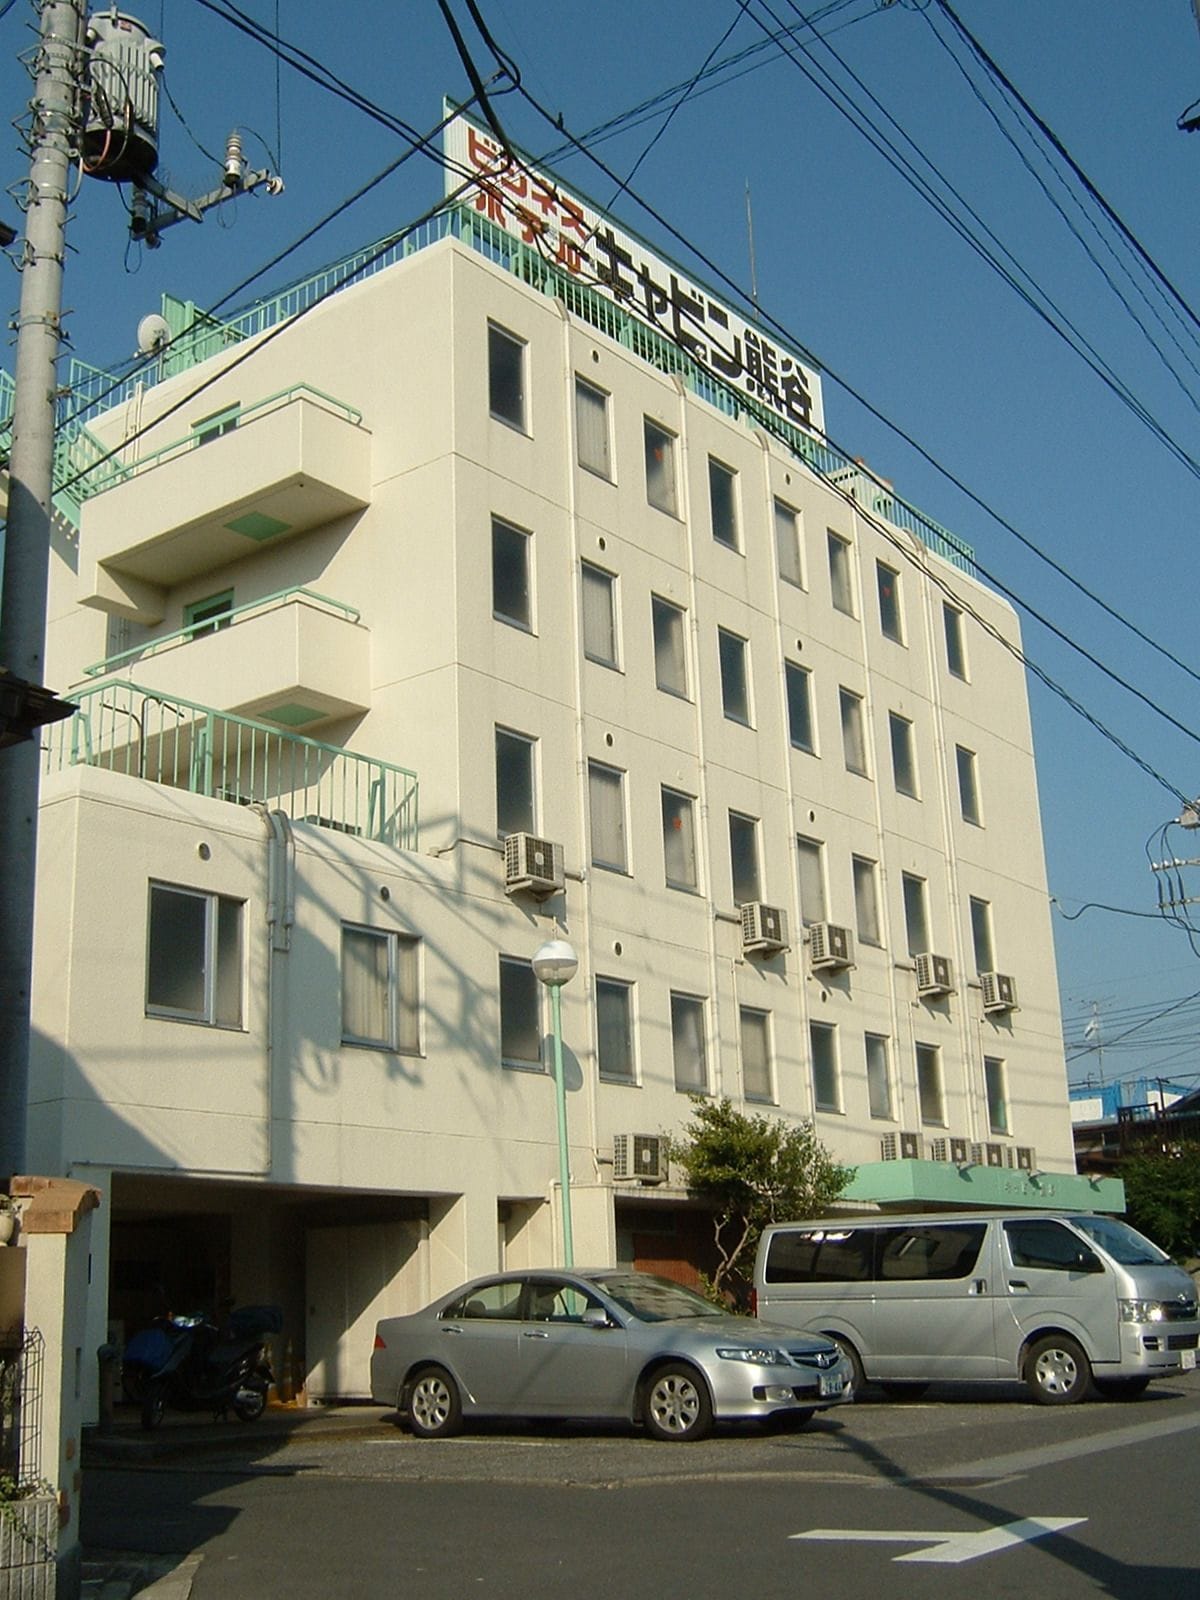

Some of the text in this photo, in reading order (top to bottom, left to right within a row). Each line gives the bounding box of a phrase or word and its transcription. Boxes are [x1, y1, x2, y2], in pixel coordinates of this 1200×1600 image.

[596, 227, 813, 431] キャビン熊谷
